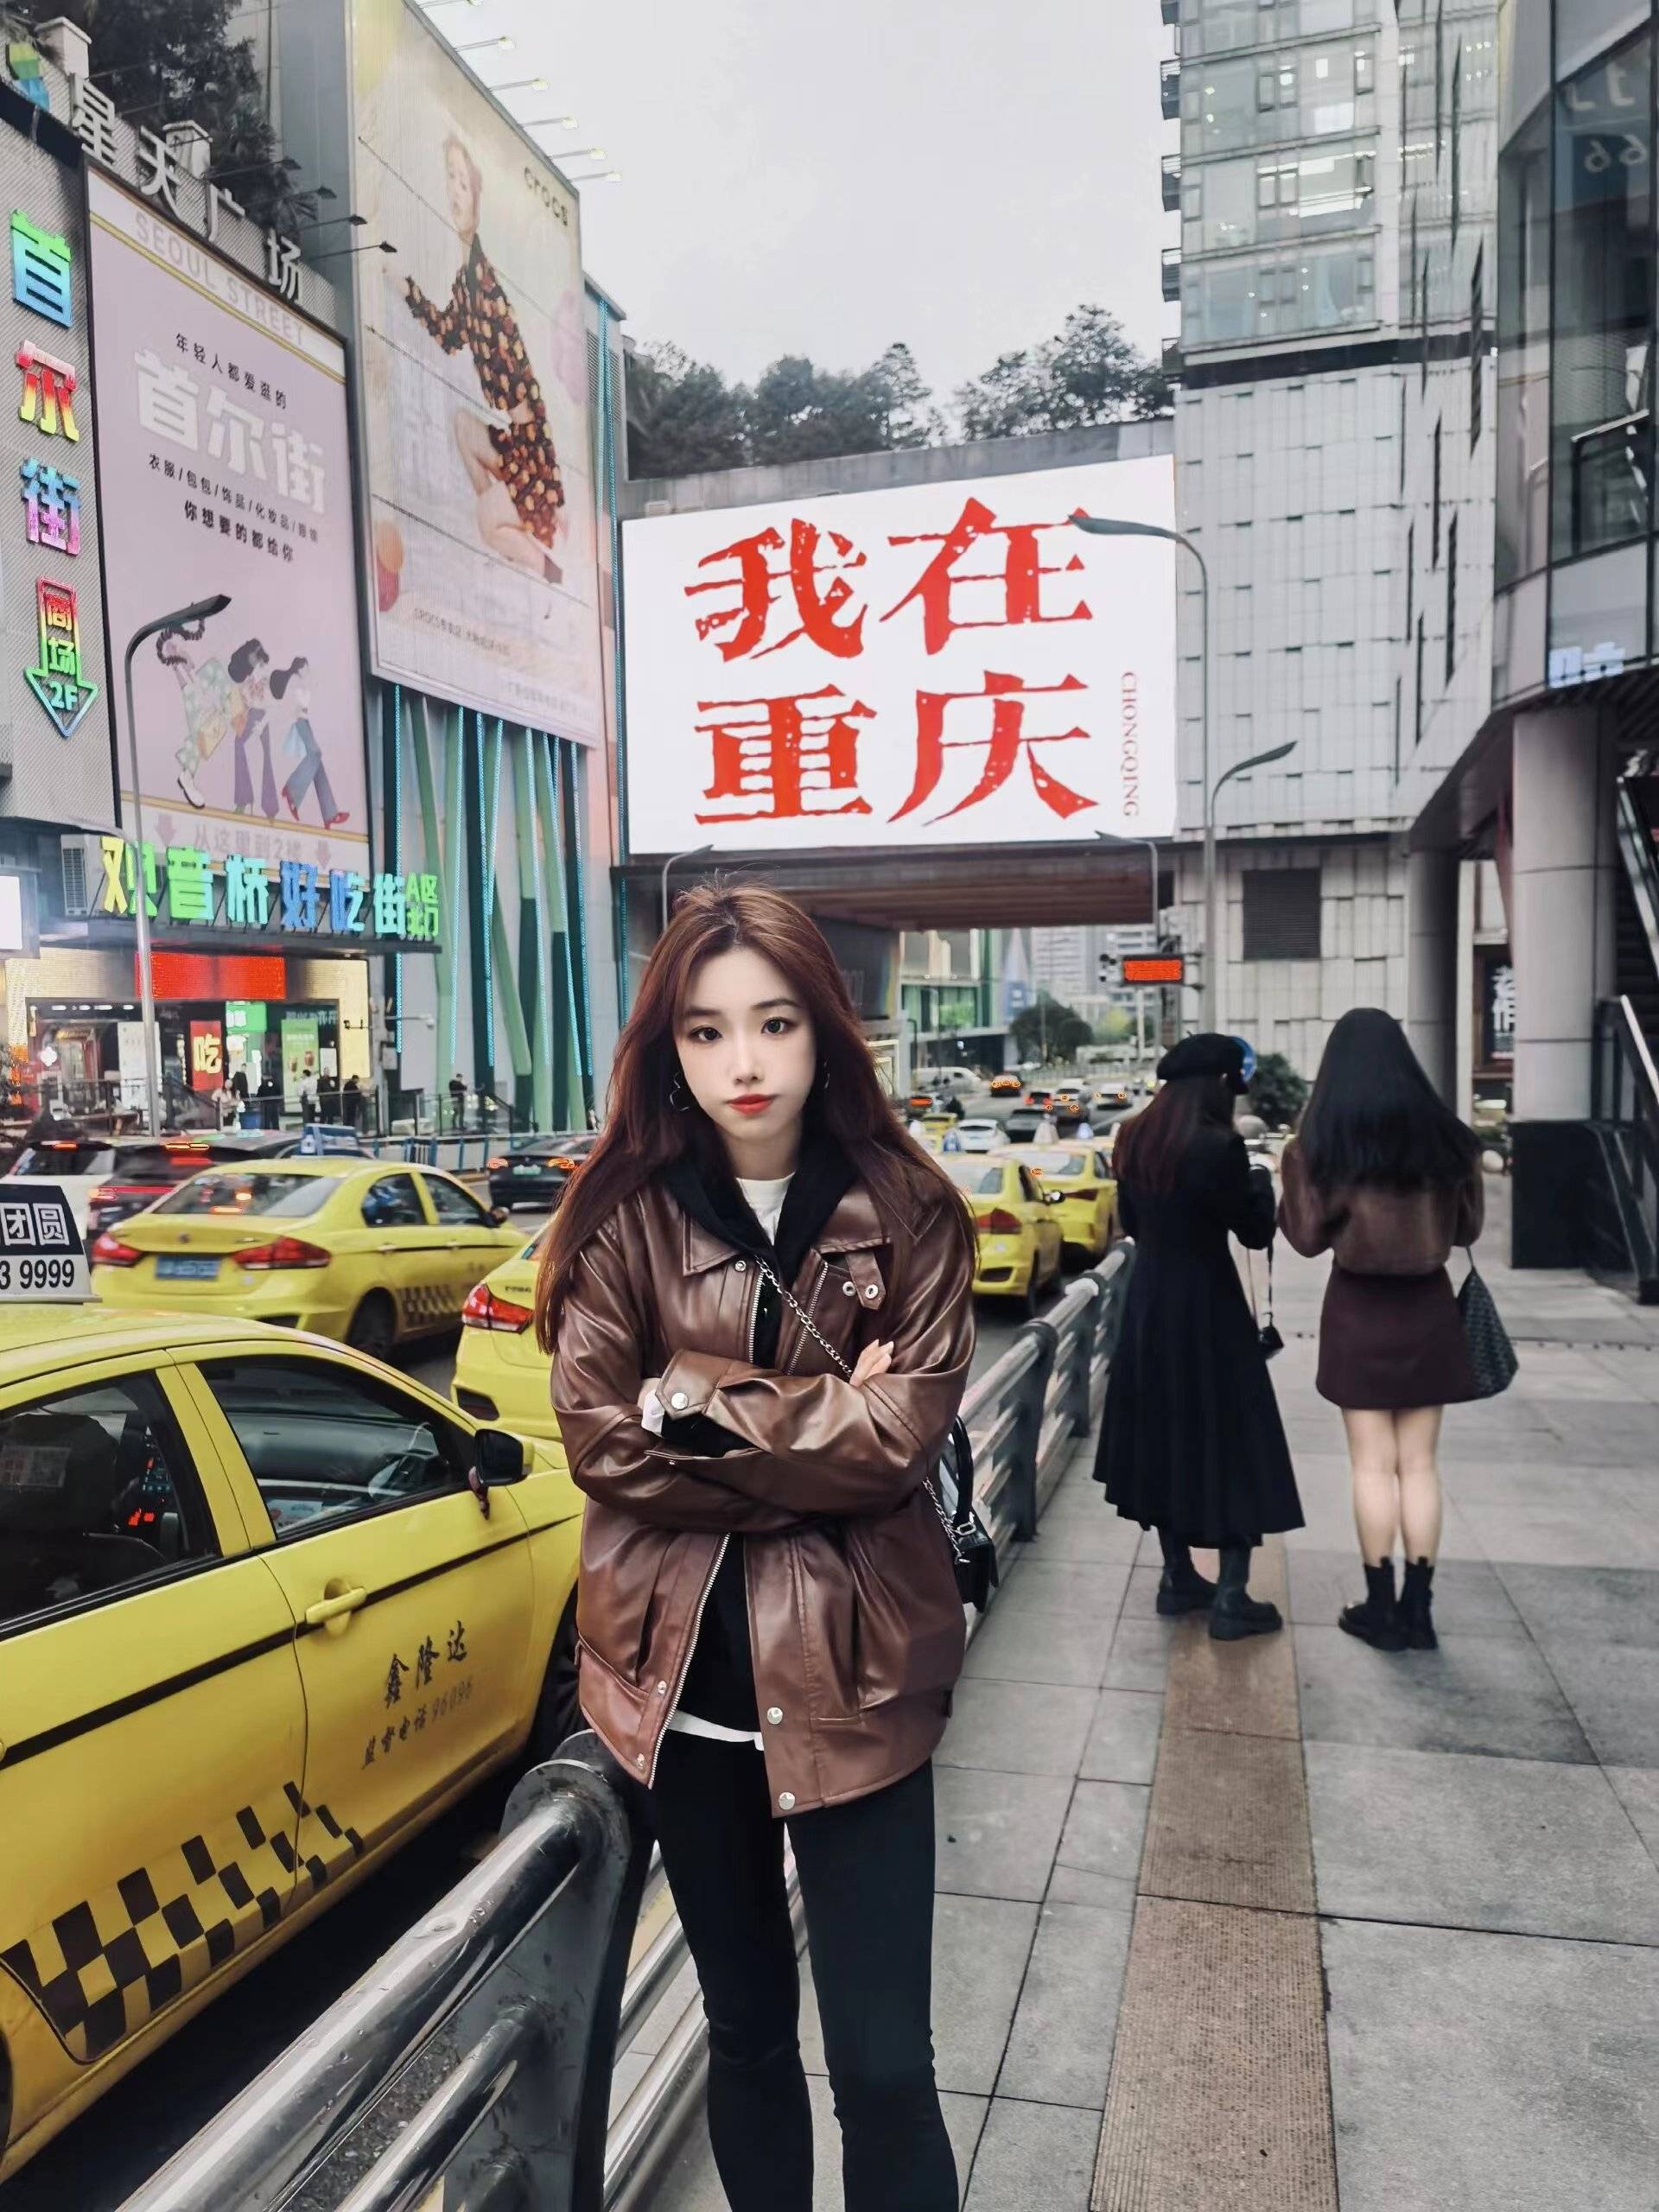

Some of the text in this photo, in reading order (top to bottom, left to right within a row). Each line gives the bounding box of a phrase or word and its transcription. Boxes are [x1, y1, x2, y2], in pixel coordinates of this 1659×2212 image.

[73, 73, 305, 304] 星天广场
[524, 166, 569, 226] crocs
[135, 209, 304, 347] SEOUL STREET
[10, 208, 82, 558] 首尔街
[134, 347, 326, 515] 首尔街
[45, 592, 76, 676] 商场
[683, 497, 1093, 664] 我在
[49, 680, 78, 711] 2F
[693, 669, 1099, 827] 重庆
[1120, 671, 1140, 817] CHONGQING
[101, 836, 407, 938] 观音桥好吃街
[193, 1033, 222, 1074] 吃
[0, 1203, 70, 1246] 团圆
[19, 1258, 75, 1290] 9999
